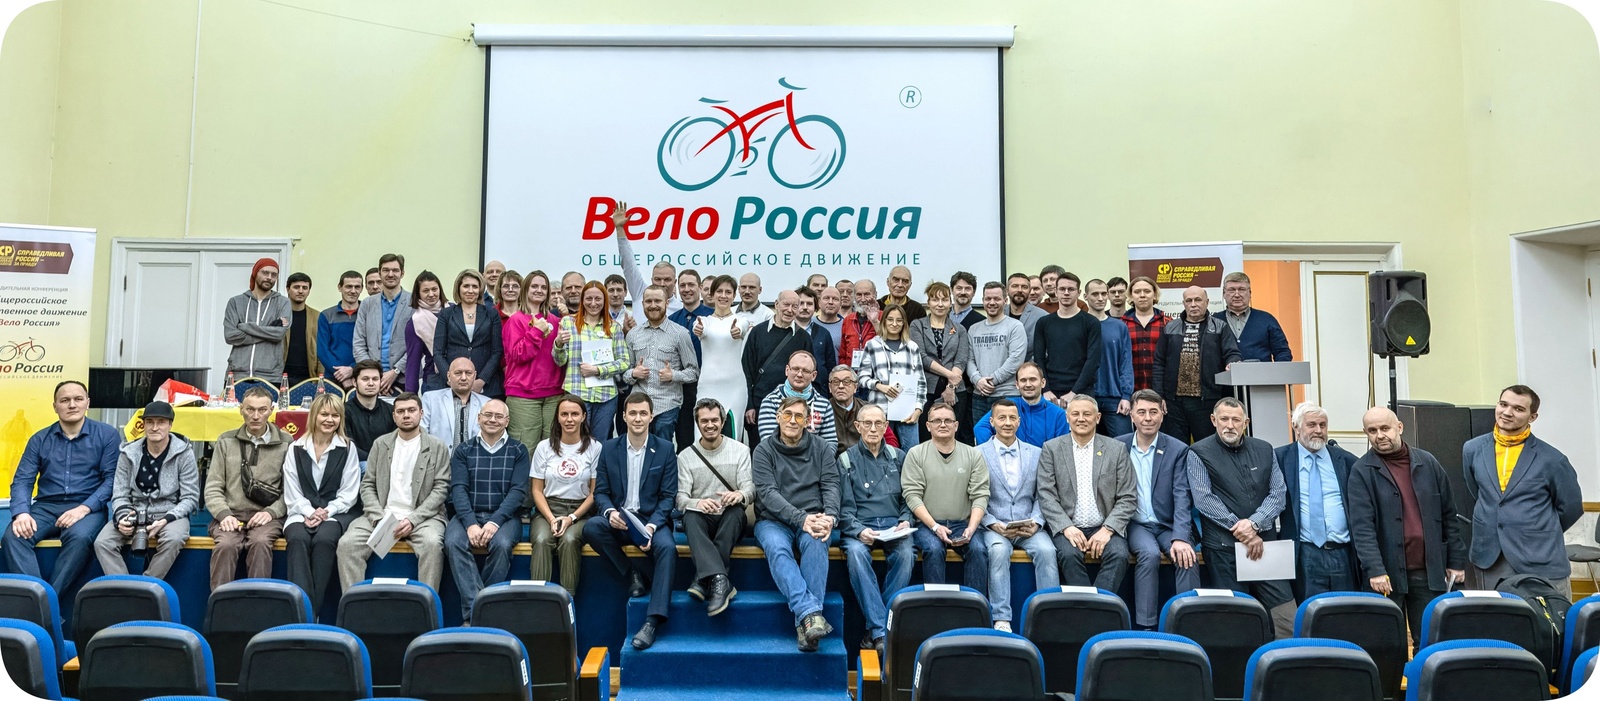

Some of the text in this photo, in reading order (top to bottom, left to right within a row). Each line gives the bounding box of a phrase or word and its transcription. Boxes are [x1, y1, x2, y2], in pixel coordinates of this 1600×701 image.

[582, 196, 923, 240] Вело Россия
[17, 250, 65, 258] СПРАВЕДЛИВАЯ
[800, 253, 921, 267] ДВИЖЕНИЕ
[1158, 264, 1170, 274] СР
[0, 295, 68, 305] щероссийское
[40, 307, 88, 317] движение
[23, 318, 61, 327] Россия»
[14, 362, 64, 373] Россия
